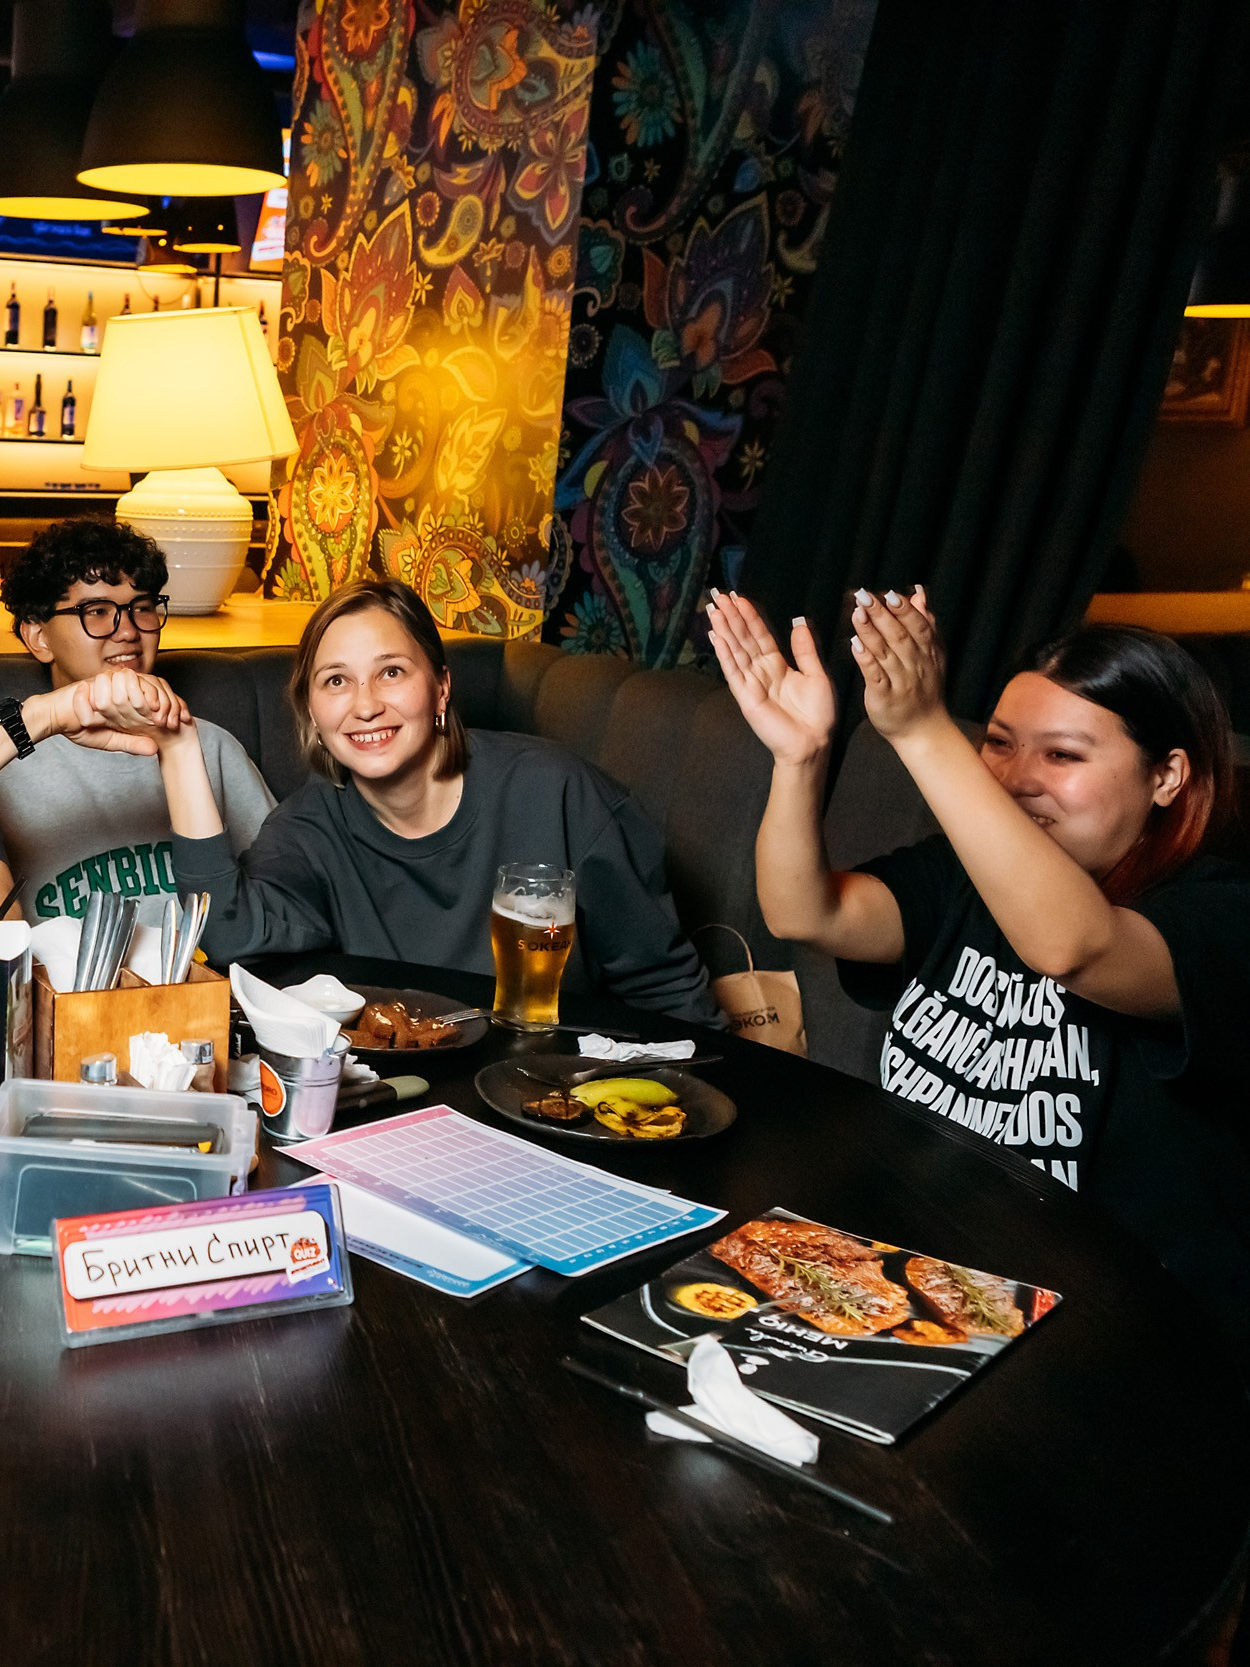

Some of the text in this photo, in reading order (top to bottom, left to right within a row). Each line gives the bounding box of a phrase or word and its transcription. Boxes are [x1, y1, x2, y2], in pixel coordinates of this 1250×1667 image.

[81, 1232, 290, 1287] Бритни Спирт
[293, 1246, 318, 1261] QUIZ
[758, 1314, 849, 1350] МЕНЮ
